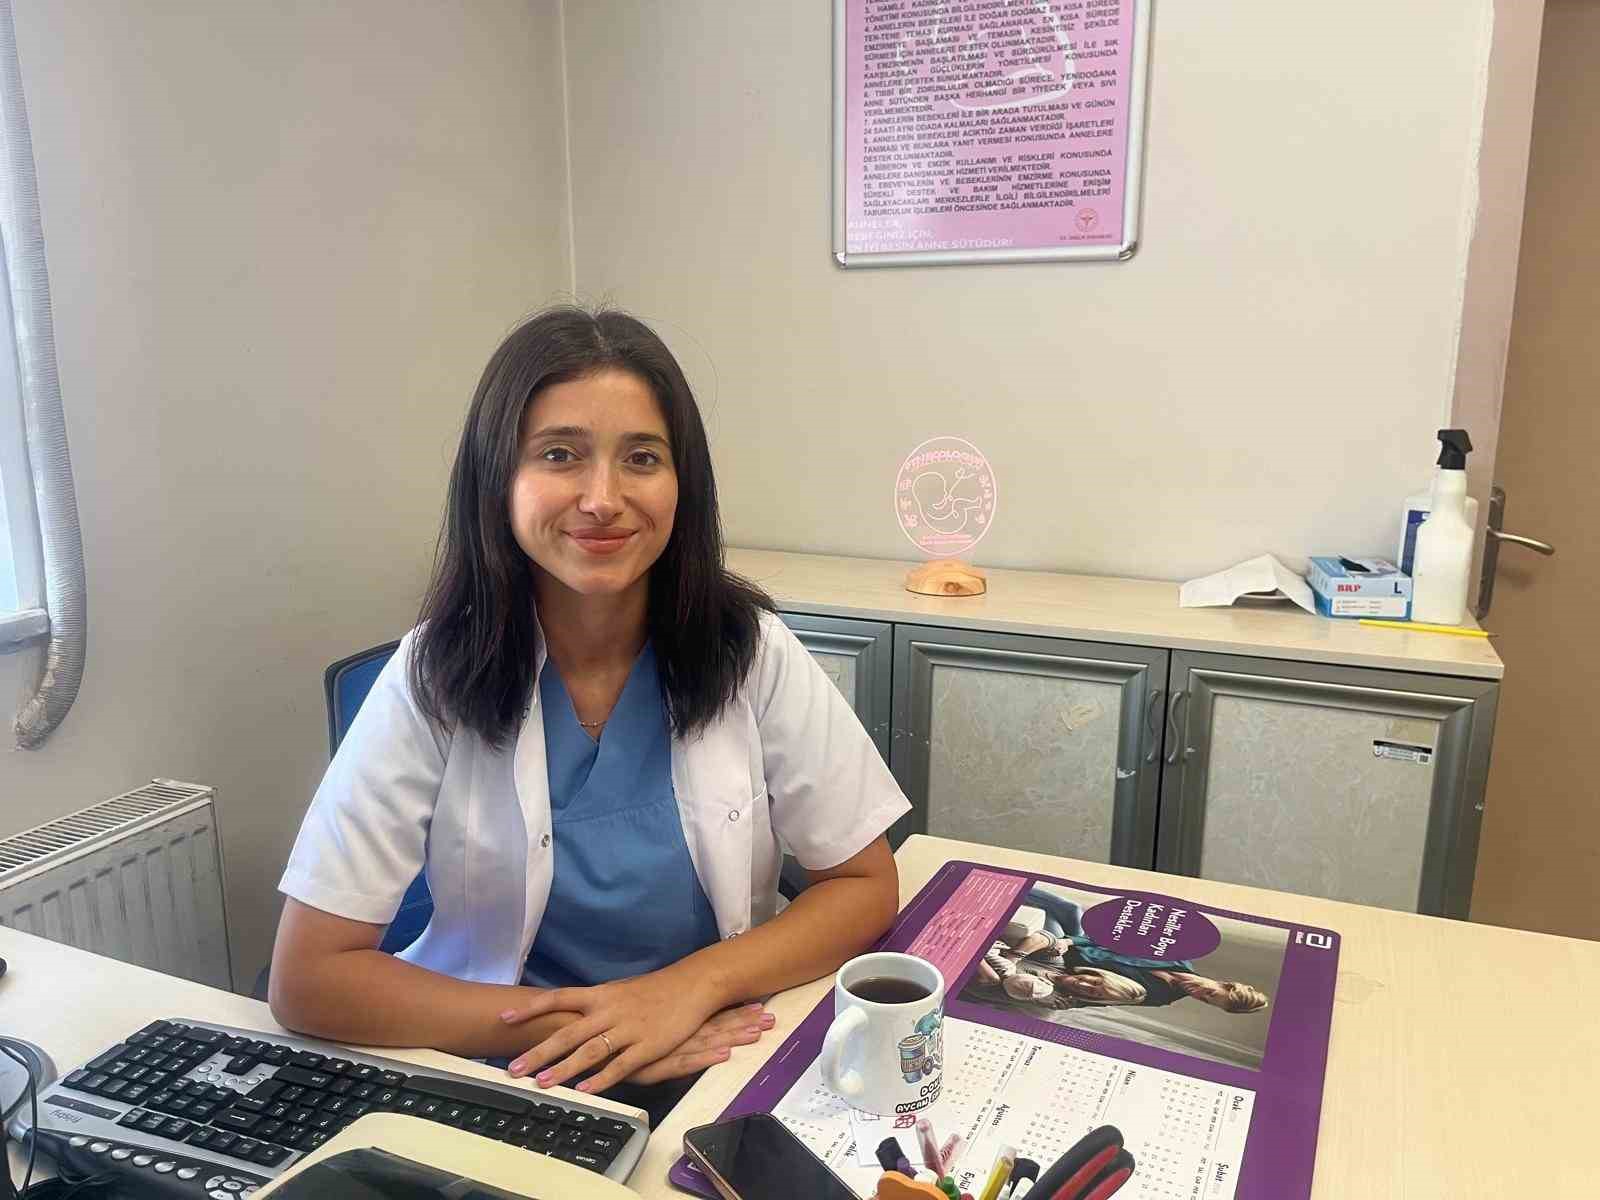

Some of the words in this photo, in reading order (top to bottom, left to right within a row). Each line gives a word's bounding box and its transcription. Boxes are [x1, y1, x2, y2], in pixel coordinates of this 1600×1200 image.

[864, 24, 869, 32] 4.
[872, 19, 915, 31] ANNELERİN
[917, 15, 961, 27] BEBEKLERİ
[963, 13, 976, 22] İLE
[979, 10, 1008, 21] DOĞAR
[1010, 6, 1045, 18] DOĞMAZ
[1049, 5, 1061, 14] EN
[1063, 2, 1082, 12] KISA
[1086, 0, 1120, 10] SÜREDE
[901, 6, 949, 19] KONUSUNDA
[905, 27, 932, 37] TEMAS
[937, 23, 972, 34] KURMASI
[978, 17, 1034, 30] SAĞLANARAK,
[1042, 16, 1054, 24] EN
[1059, 13, 1079, 22] KISA
[1086, 9, 1120, 20] SÜREDE
[864, 40, 906, 51] EMZİRMEYE
[915, 34, 960, 46] BAŞLAMASI
[967, 33, 977, 41] VE
[986, 29, 1021, 40] TEMASIN
[1083, 19, 1119, 30] ŞEKİLDE
[876, 57, 924, 68] EMZİRMENİN
[930, 51, 987, 64] BAŞLATILMASI
[993, 49, 1004, 58] VE
[1083, 41, 1096, 50] İLE
[1103, 39, 1118, 48] SIK
[914, 44, 956, 56] ANNELERE
[958, 41, 989, 52] DESTEK
[991, 35, 1056, 49] OLUNMAKTADIR.
[864, 67, 918, 79] KARŞILAŞILAN
[929, 61, 984, 73] GÜÇLÜKLERİN
[998, 55, 1051, 67] YÖNETİLMESİ
[1064, 49, 1117, 62] KONUSUNDA
[864, 78, 902, 88] ANNELERE
[904, 75, 934, 85] DESTEK
[936, 69, 1005, 82] SUNULMAKTADIR.
[875, 88, 894, 97] TIBBİ
[898, 86, 912, 95] BİR
[916, 82, 969, 93] ZORUNLULUK
[974, 78, 1014, 88] OLMADIĞI
[1018, 74, 1054, 85] SÜRECE,
[1060, 69, 1116, 82] YENİDOĞANA
[864, 98, 883, 107] ANNE
[888, 94, 928, 105] SÜTÜNDEN
[934, 92, 960, 101] BAŞKA
[965, 88, 1007, 99] HERHANGİ
[1012, 86, 1025, 95] BİR
[1031, 83, 1066, 93] YİYECEK
[1072, 80, 1094, 90] VEYA
[1100, 79, 1116, 88] SIVI
[864, 103, 935, 116] VERİLMEMEKTEDİR.
[872, 114, 914, 125] ANNELERİN
[916, 111, 959, 122] BEBEKLERİ
[961, 110, 974, 118] İLE
[975, 108, 989, 117] BİR
[991, 106, 1019, 116] ARADA
[1022, 102, 1068, 114] TUTULMASI
[1071, 101, 1082, 110] VE
[1083, 99, 1115, 109] GÜNÜN
[872, 133, 914, 143] ANNELERİN
[916, 130, 959, 140] BEBEKLERİ
[997, 125, 1026, 134] ZAMAN
[1028, 122, 1063, 132] VERDİĞİ
[1065, 118, 1114, 130] İŞARETLERİ
[896, 124, 913, 132] AYNI
[915, 121, 943, 131] ODADA
[943, 118, 988, 129] KALMALARI
[989, 112, 1065, 126] SAĞLANMAKTADIR.
[900, 142, 911, 150] VE
[913, 140, 949, 150] BUNLARA
[951, 138, 974, 147] YANIT
[977, 135, 1012, 145] VERMESİ
[1014, 132, 1065, 143] KONUSUNDA
[1068, 128, 1113, 139] ANNELERE
[863, 154, 892, 162] DESTEK
[893, 149, 955, 160] OLUNMAKTADIR.
[874, 161, 908, 171] BİBERON
[912, 160, 921, 169] VE
[927, 158, 951, 168] EMZİK
[955, 156, 997, 166] KULLANIMI
[1001, 154, 1012, 163] VE
[1017, 152, 1055, 162] RİSKLERİ
[1060, 148, 1112, 159] KONUSUNDA
[864, 171, 902, 181] ANNELERE
[955, 166, 986, 175] HİZMETİ
[987, 162, 1051, 173] VERİLMEKTEDİR.
[878, 178, 934, 189] EBEVEYNLERİN
[939, 177, 950, 186] VE
[955, 174, 1012, 184] BEBEKLERİNİN
[1017, 171, 1053, 181] EMZİRME
[1058, 168, 1112, 178] KONUSUNDA
[906, 188, 936, 197] DESTEK
[972, 184, 998, 193] BAKIM
[1011, 180, 1068, 191] HİZMETLERİNE
[1082, 177, 1111, 187] ERİŞİM
[934, 194, 990, 204] MERKEZLERLE
[995, 192, 1018, 201] İLGİLİ
[1023, 187, 1111, 199] BİLGİLENDİRİLMELERİ
[954, 202, 998, 212] ÖNCESİNDE
[999, 198, 1075, 210] SAĞLANMAKTADIR.
[1394, 582, 1402, 594] L
[1162, 908, 1186, 937] Nesiller
[1150, 937, 1176, 956] Boyu
[1024, 1044, 1042, 1066] Temmuz
[1123, 1070, 1137, 1086] Nisan
[896, 1096, 929, 1113] AYCAN
[1231, 1096, 1244, 1112] Ocak
[991, 1104, 1011, 1127] Ağustos
[959, 1171, 975, 1190] Eylül
[1214, 1163, 1229, 1182] Şubat
